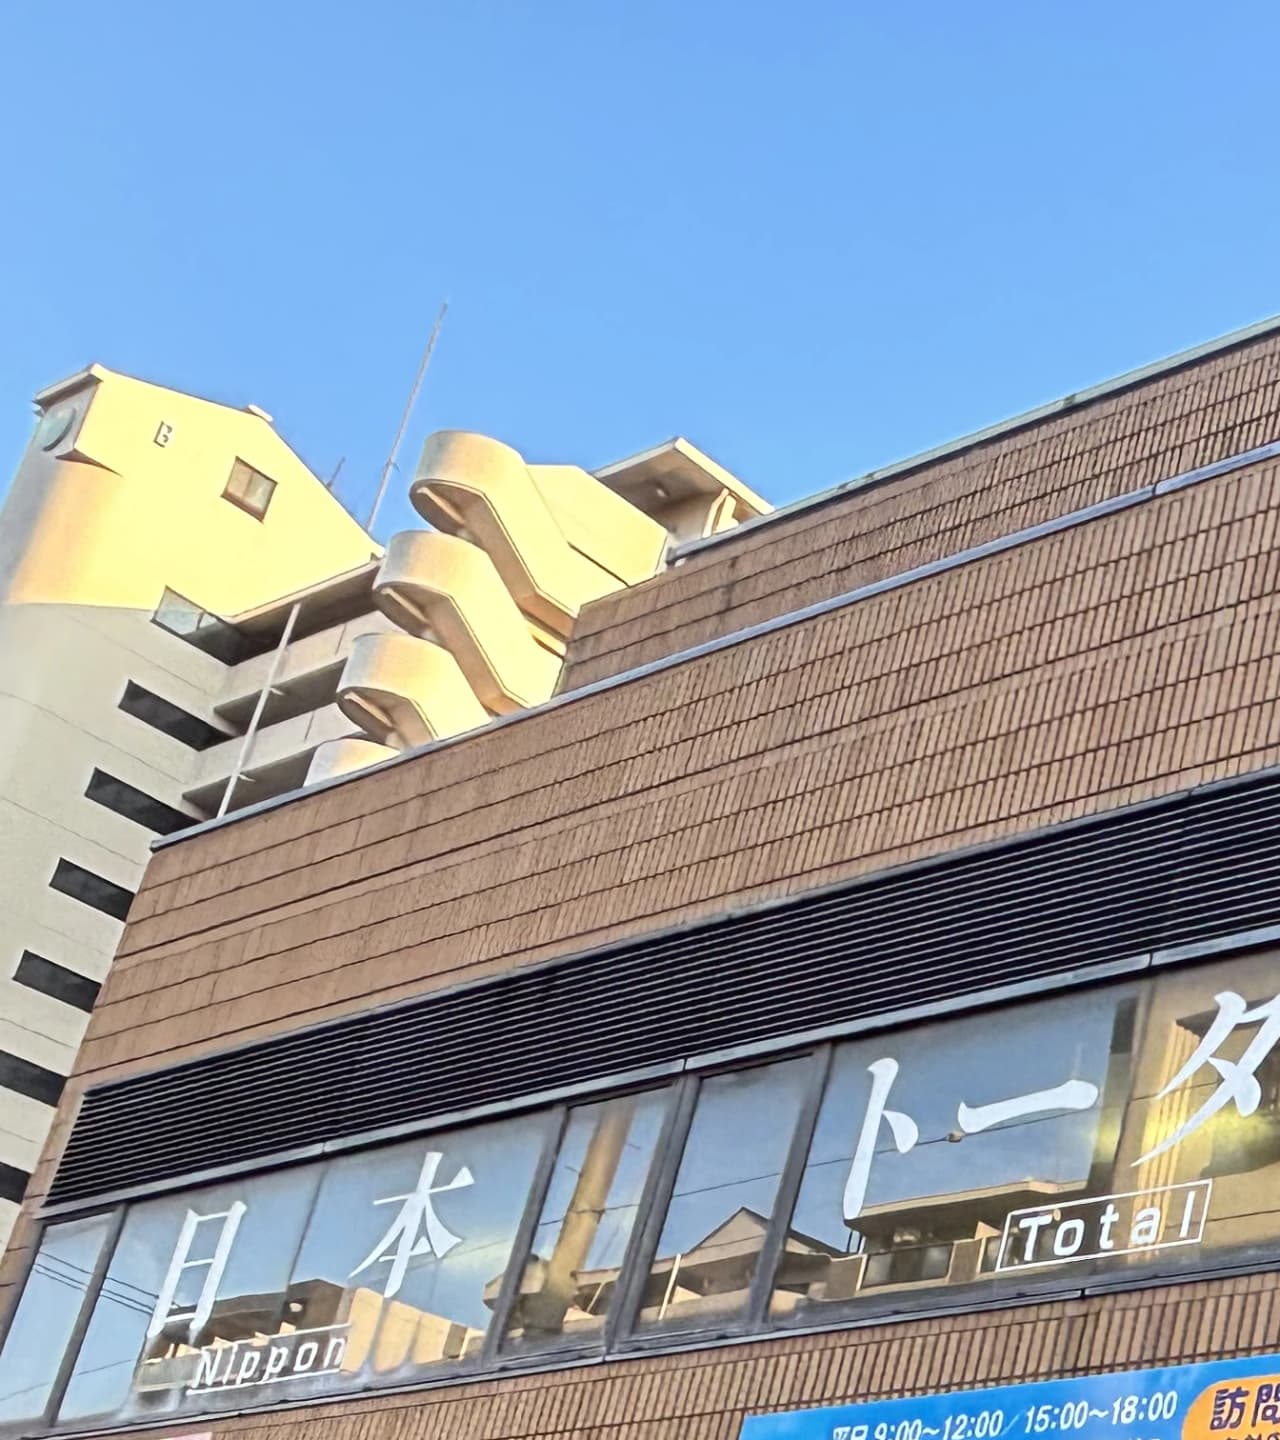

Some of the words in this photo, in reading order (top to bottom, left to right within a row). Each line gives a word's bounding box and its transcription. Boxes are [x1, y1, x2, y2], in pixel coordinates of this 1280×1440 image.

[148, 1152, 475, 1338] 日本
[192, 1337, 347, 1388] Nippon
[1018, 1190, 1197, 1261] Total
